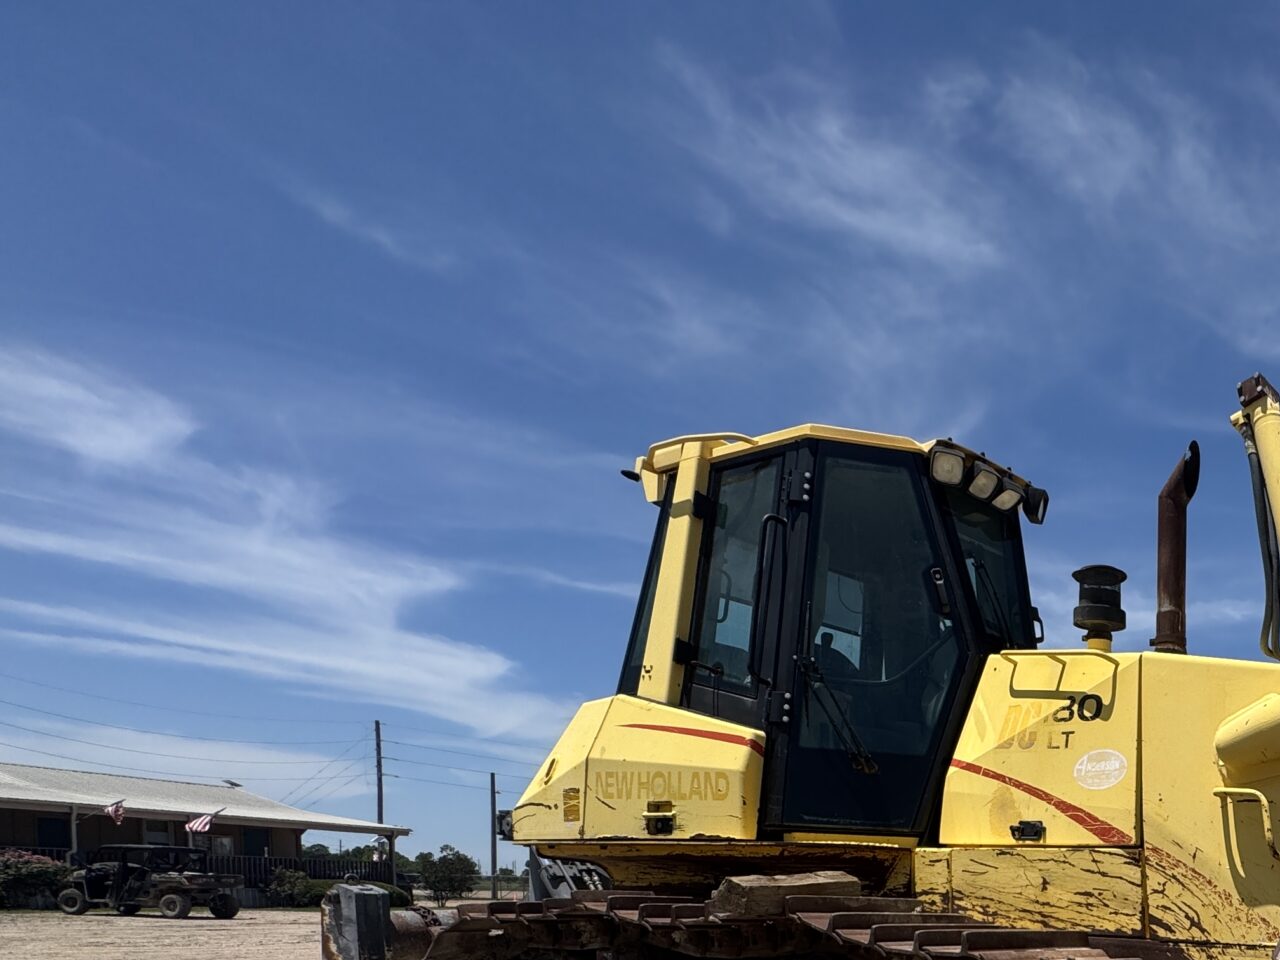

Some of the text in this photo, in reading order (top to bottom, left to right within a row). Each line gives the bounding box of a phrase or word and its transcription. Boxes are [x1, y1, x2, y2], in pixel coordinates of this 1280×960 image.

[1047, 730, 1075, 749] LT
[595, 770, 729, 801] NEW HOLLAND
